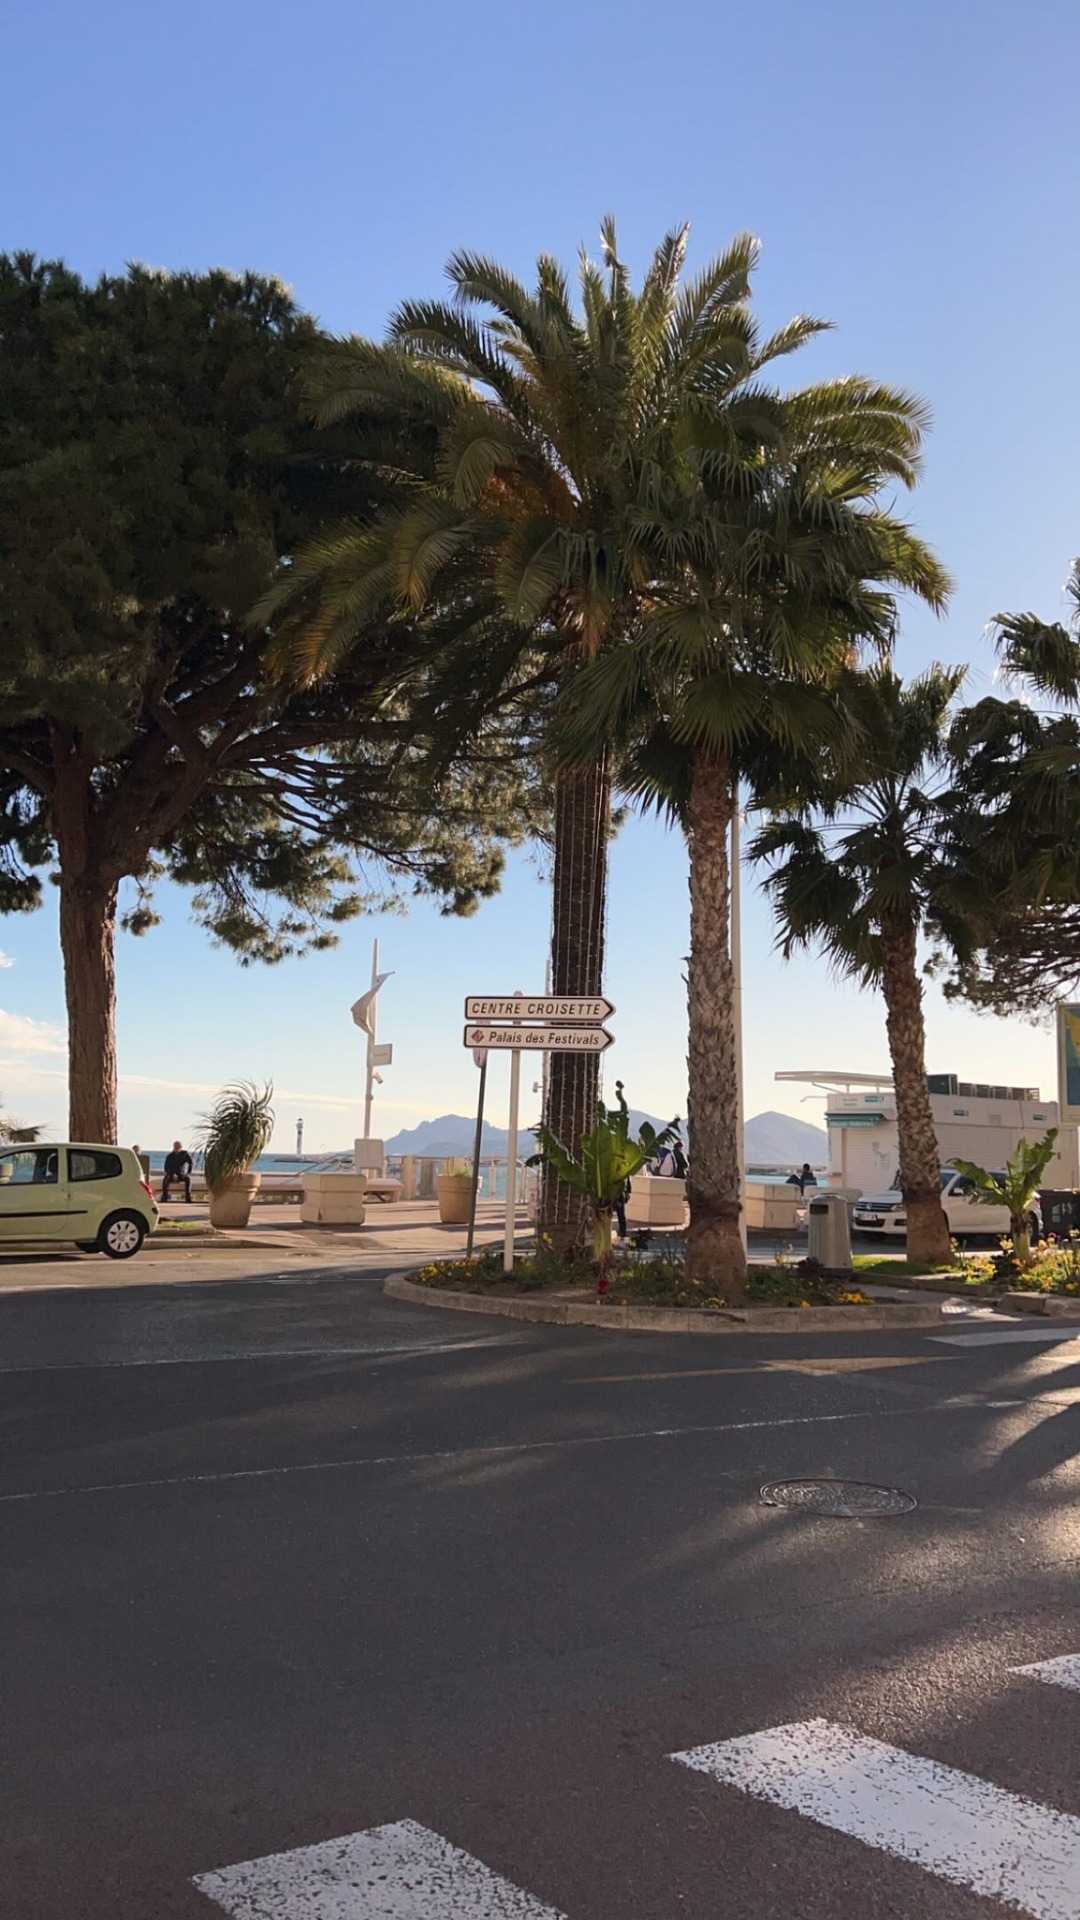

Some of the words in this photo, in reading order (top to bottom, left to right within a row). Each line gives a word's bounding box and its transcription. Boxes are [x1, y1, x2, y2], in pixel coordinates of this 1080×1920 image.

[472, 1002, 521, 1014] CENTRE
[528, 1003, 601, 1015] CROISETTE
[489, 1031, 522, 1043] Palais
[525, 1033, 544, 1044] des
[548, 1032, 600, 1045] Festivals
